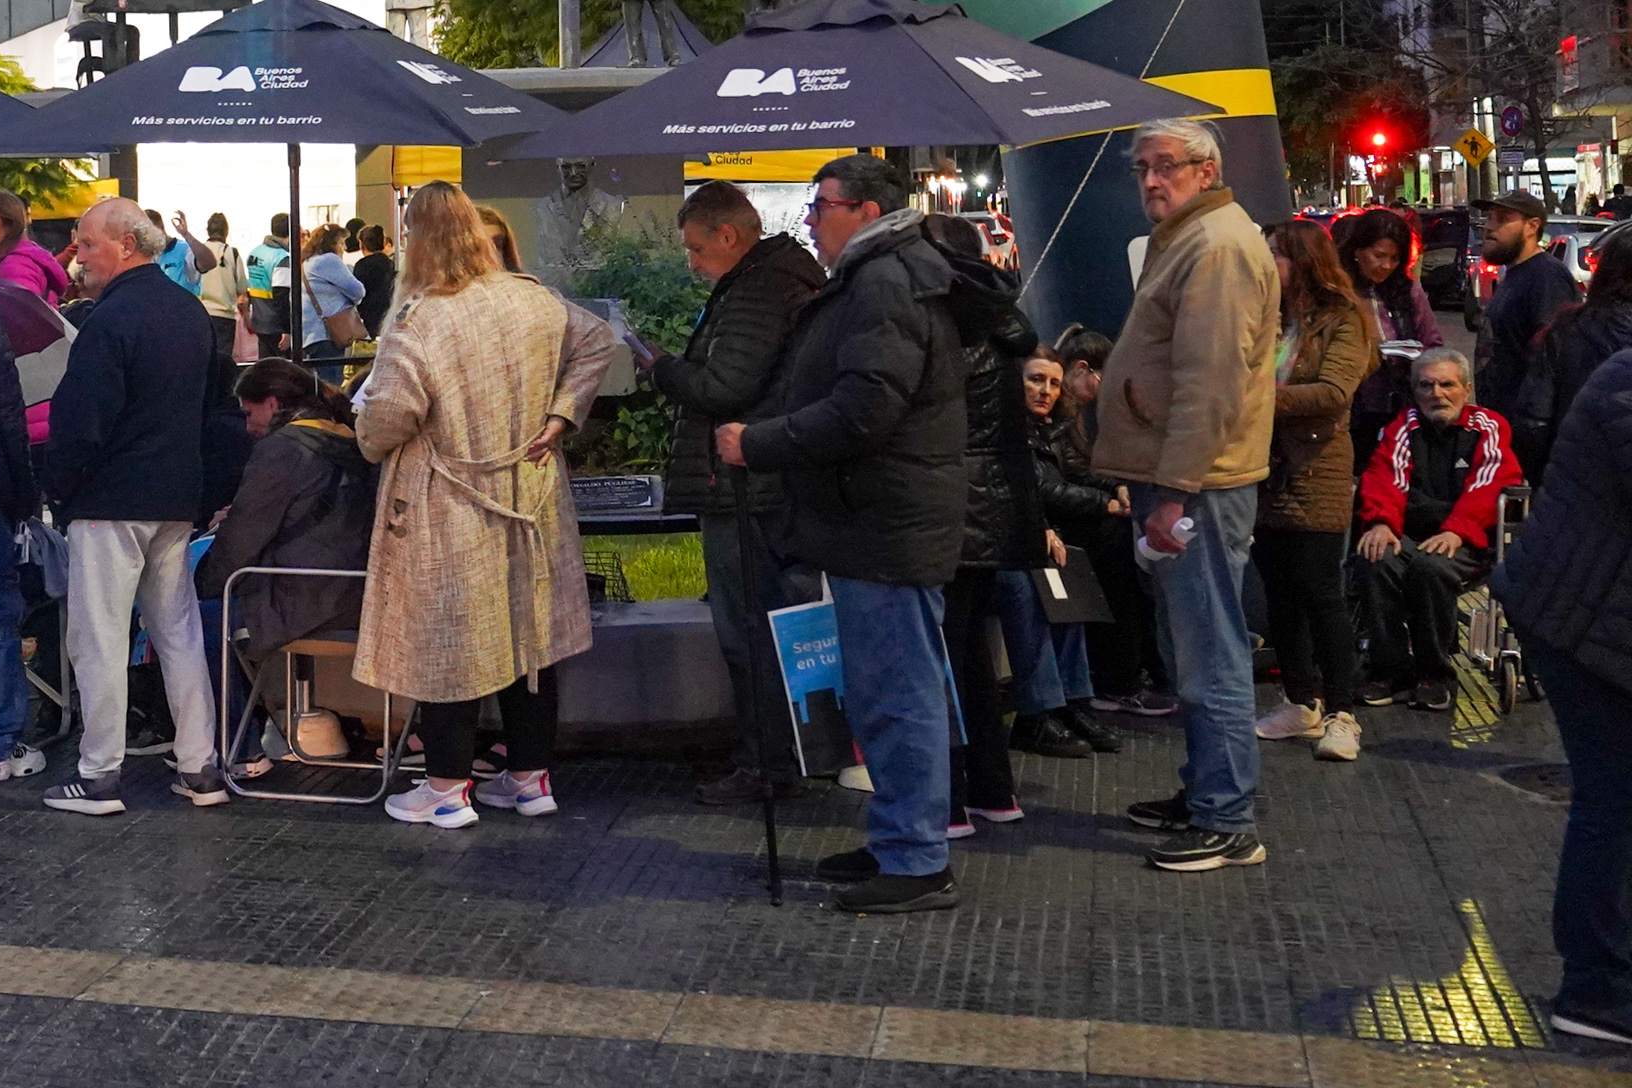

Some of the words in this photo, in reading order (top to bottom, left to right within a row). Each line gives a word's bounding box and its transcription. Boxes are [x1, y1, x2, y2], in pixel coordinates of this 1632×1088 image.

[254, 66, 303, 76] Buenos
[796, 67, 847, 78] Buenos
[178, 65, 256, 92] BA
[258, 74, 296, 82] Aires
[717, 67, 797, 97] BA
[799, 75, 838, 85] Aires
[260, 79, 310, 90] Ciudad
[800, 80, 851, 92] Ciudad
[131, 116, 164, 125] Más
[166, 116, 236, 125] servicios
[237, 117, 257, 125] en
[259, 116, 275, 125] tu
[276, 115, 323, 125] barrio
[662, 124, 696, 134] Más
[697, 122, 767, 134] servicios
[768, 122, 789, 132] en
[790, 121, 808, 131] tu
[808, 118, 856, 130] barrio
[715, 155, 754, 165] Ciudad
[796, 657, 816, 670] en
[819, 653, 837, 666] tu
